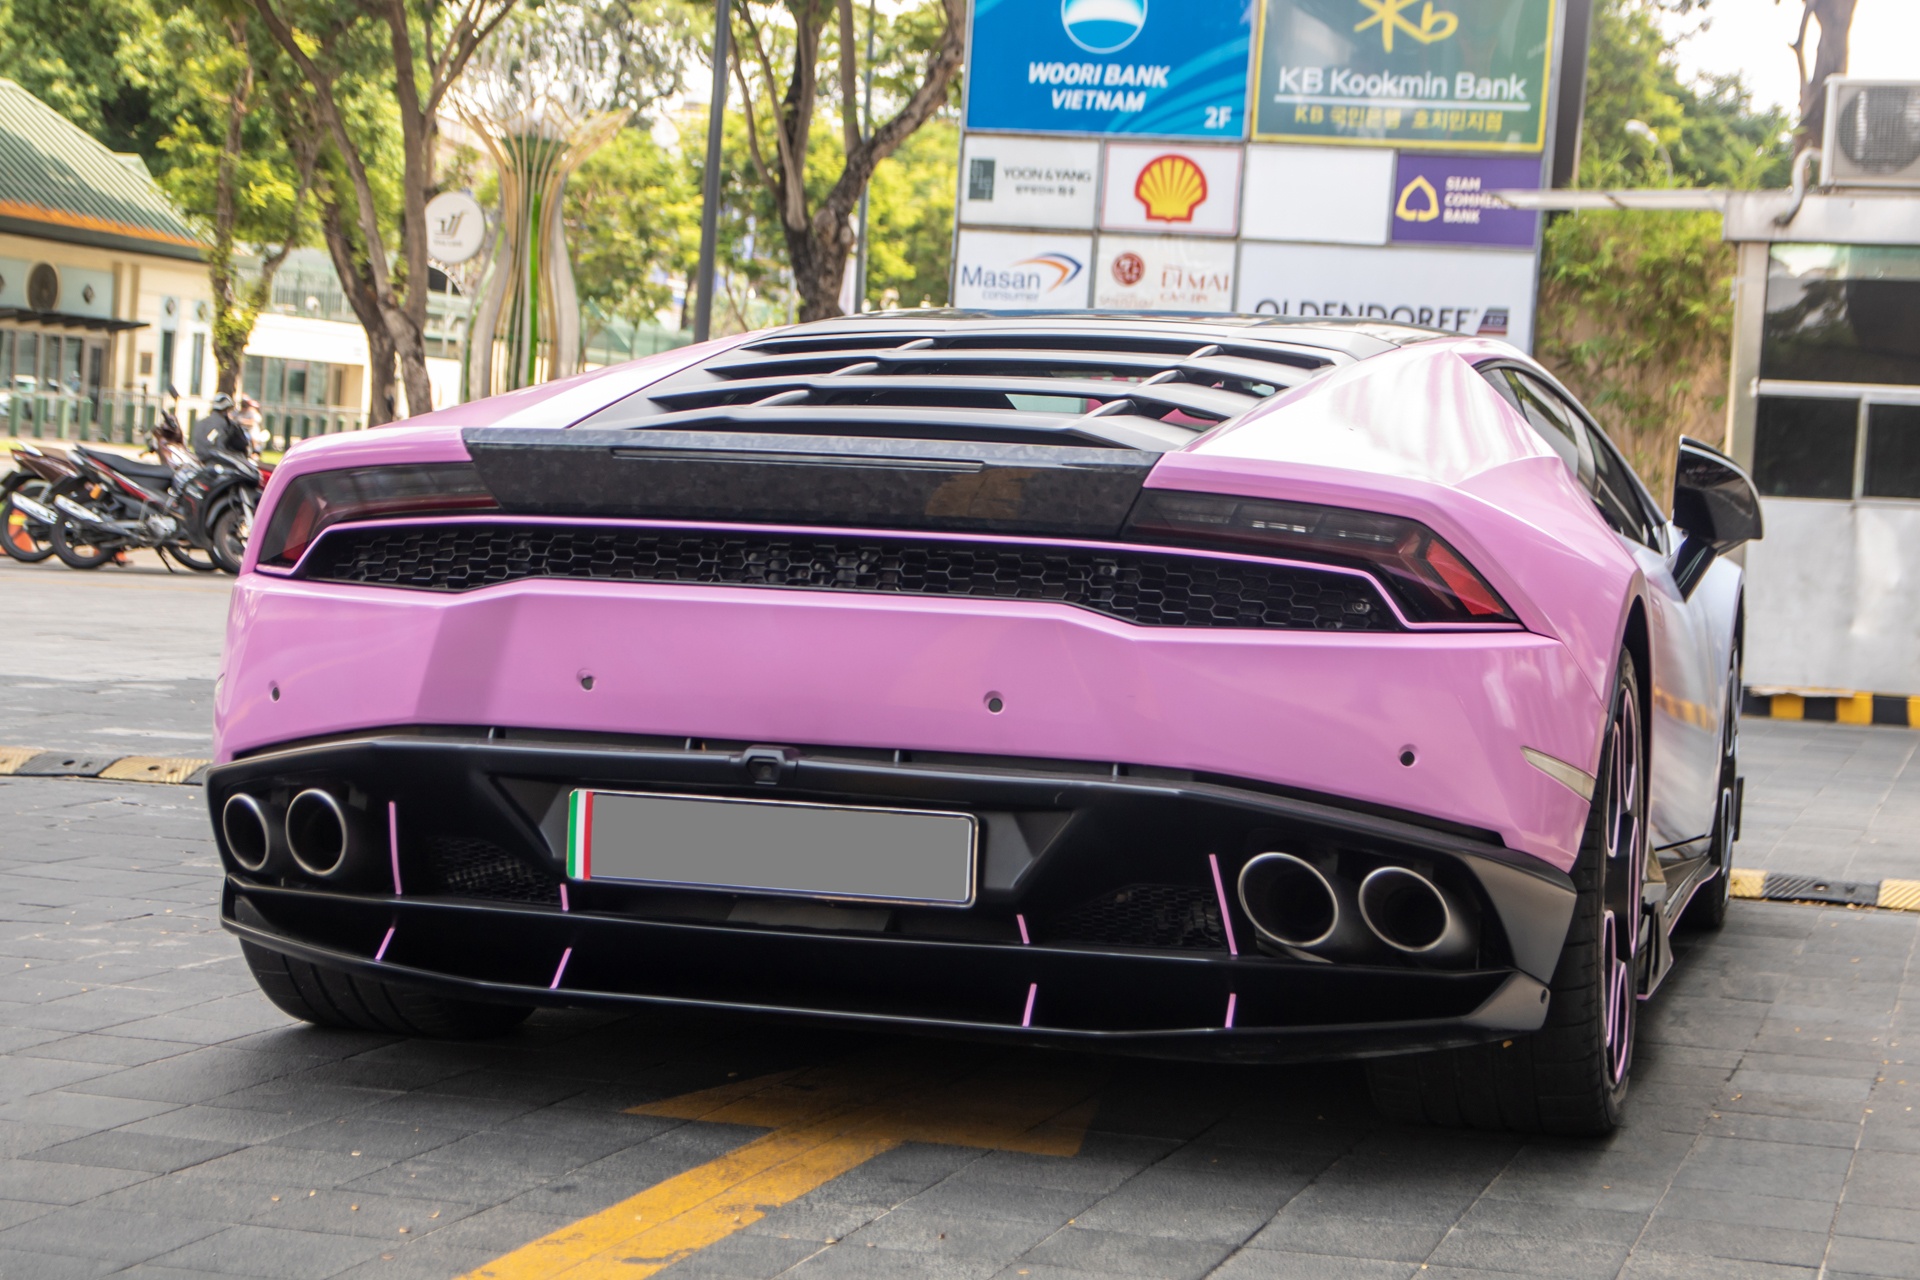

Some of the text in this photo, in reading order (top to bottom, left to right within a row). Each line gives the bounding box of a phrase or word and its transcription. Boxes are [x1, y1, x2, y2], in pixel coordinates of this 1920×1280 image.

[1028, 61, 1170, 88] WOORI BANK
[1278, 66, 1527, 101] KB Kookmin Bank
[1051, 88, 1147, 112] VIETNAM
[1203, 105, 1232, 129] 2F
[1294, 106, 1324, 124] KB
[1003, 167, 1043, 180] YOON
[1055, 168, 1091, 182] YANG
[1445, 176, 1481, 192] SIAM
[1443, 208, 1480, 224] BANK
[961, 264, 1041, 290] Masan
[982, 290, 1039, 302] consumer
